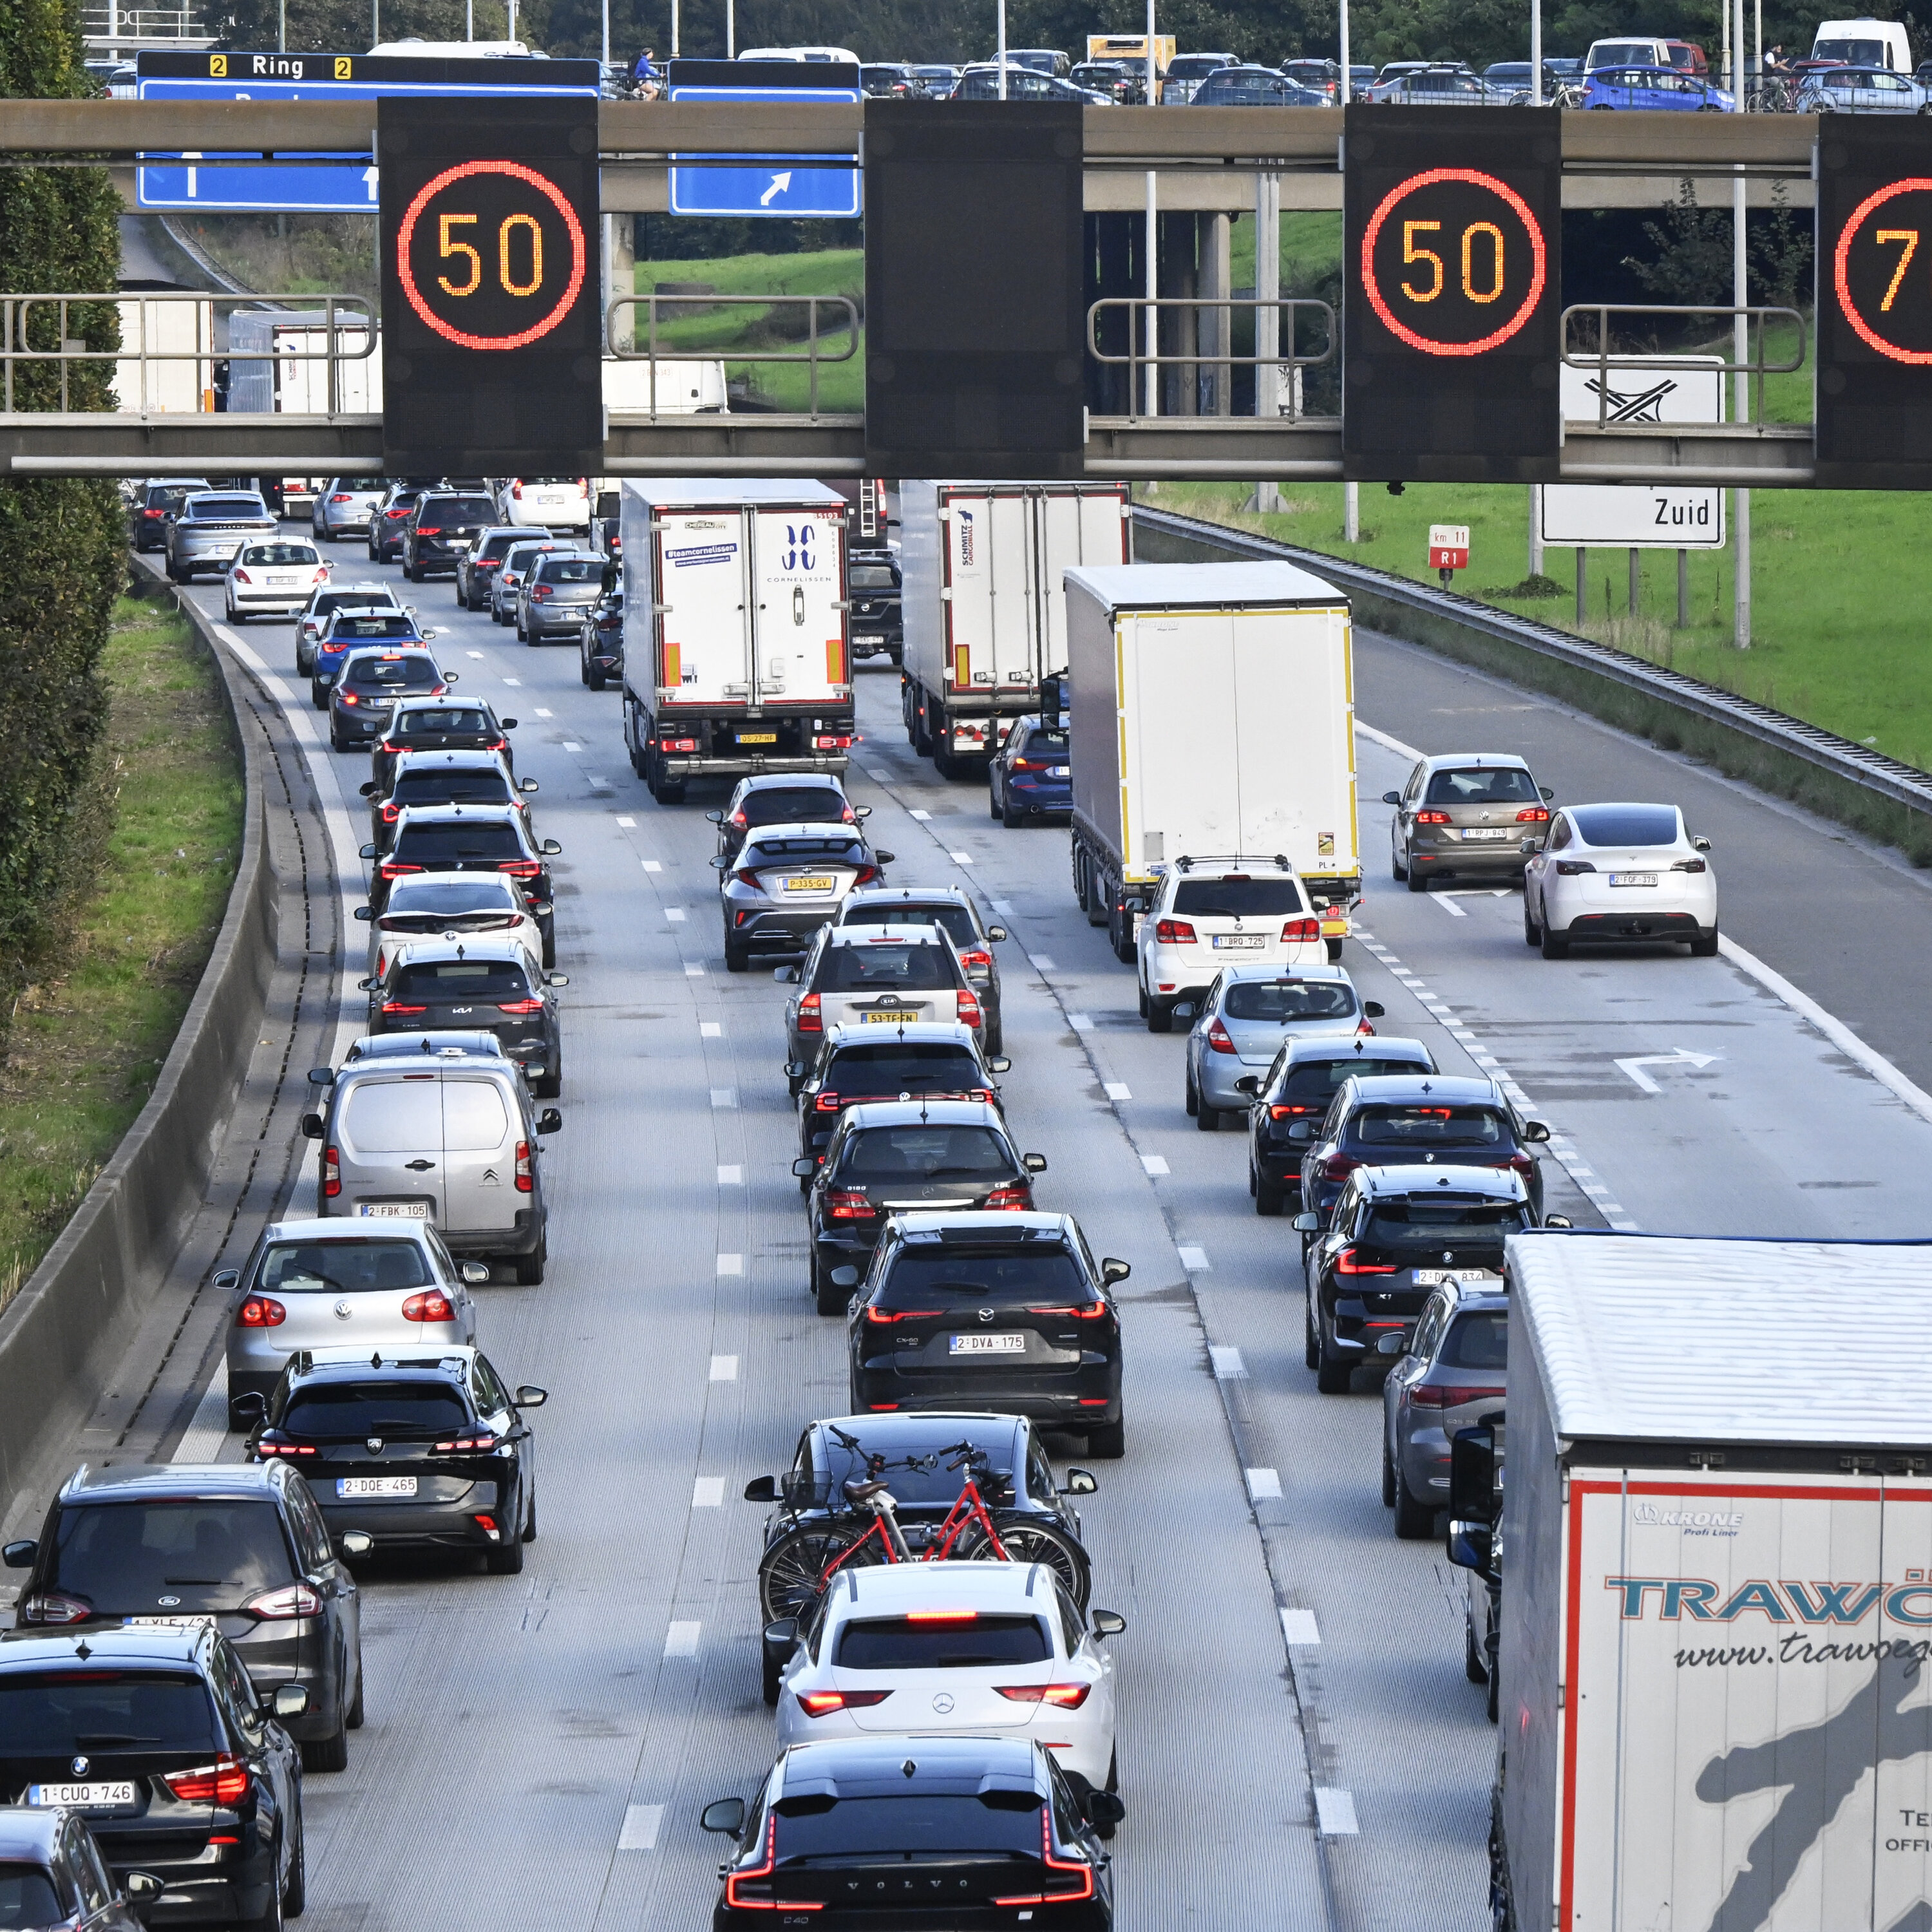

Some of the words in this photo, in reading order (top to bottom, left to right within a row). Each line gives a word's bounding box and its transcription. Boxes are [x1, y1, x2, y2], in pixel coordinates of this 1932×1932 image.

[213, 58, 223, 74] 2
[253, 55, 303, 79] Ring
[337, 61, 348, 76] 2
[438, 214, 543, 296] 50
[1401, 220, 1504, 303] 50
[1655, 498, 1709, 525] Zuid
[1435, 533, 1446, 542] km
[1455, 531, 1464, 543] 11
[668, 545, 735, 558] #teamcornelissen
[791, 880, 827, 888] P-335-GV
[1660, 1511, 1743, 1527] KRONE
[1674, 1631, 1932, 1678] www.trawoeg
[1899, 1810, 1932, 1827] TE
[1886, 1839, 1932, 1852] OFFI
[848, 1880, 967, 1889] VOLVO
